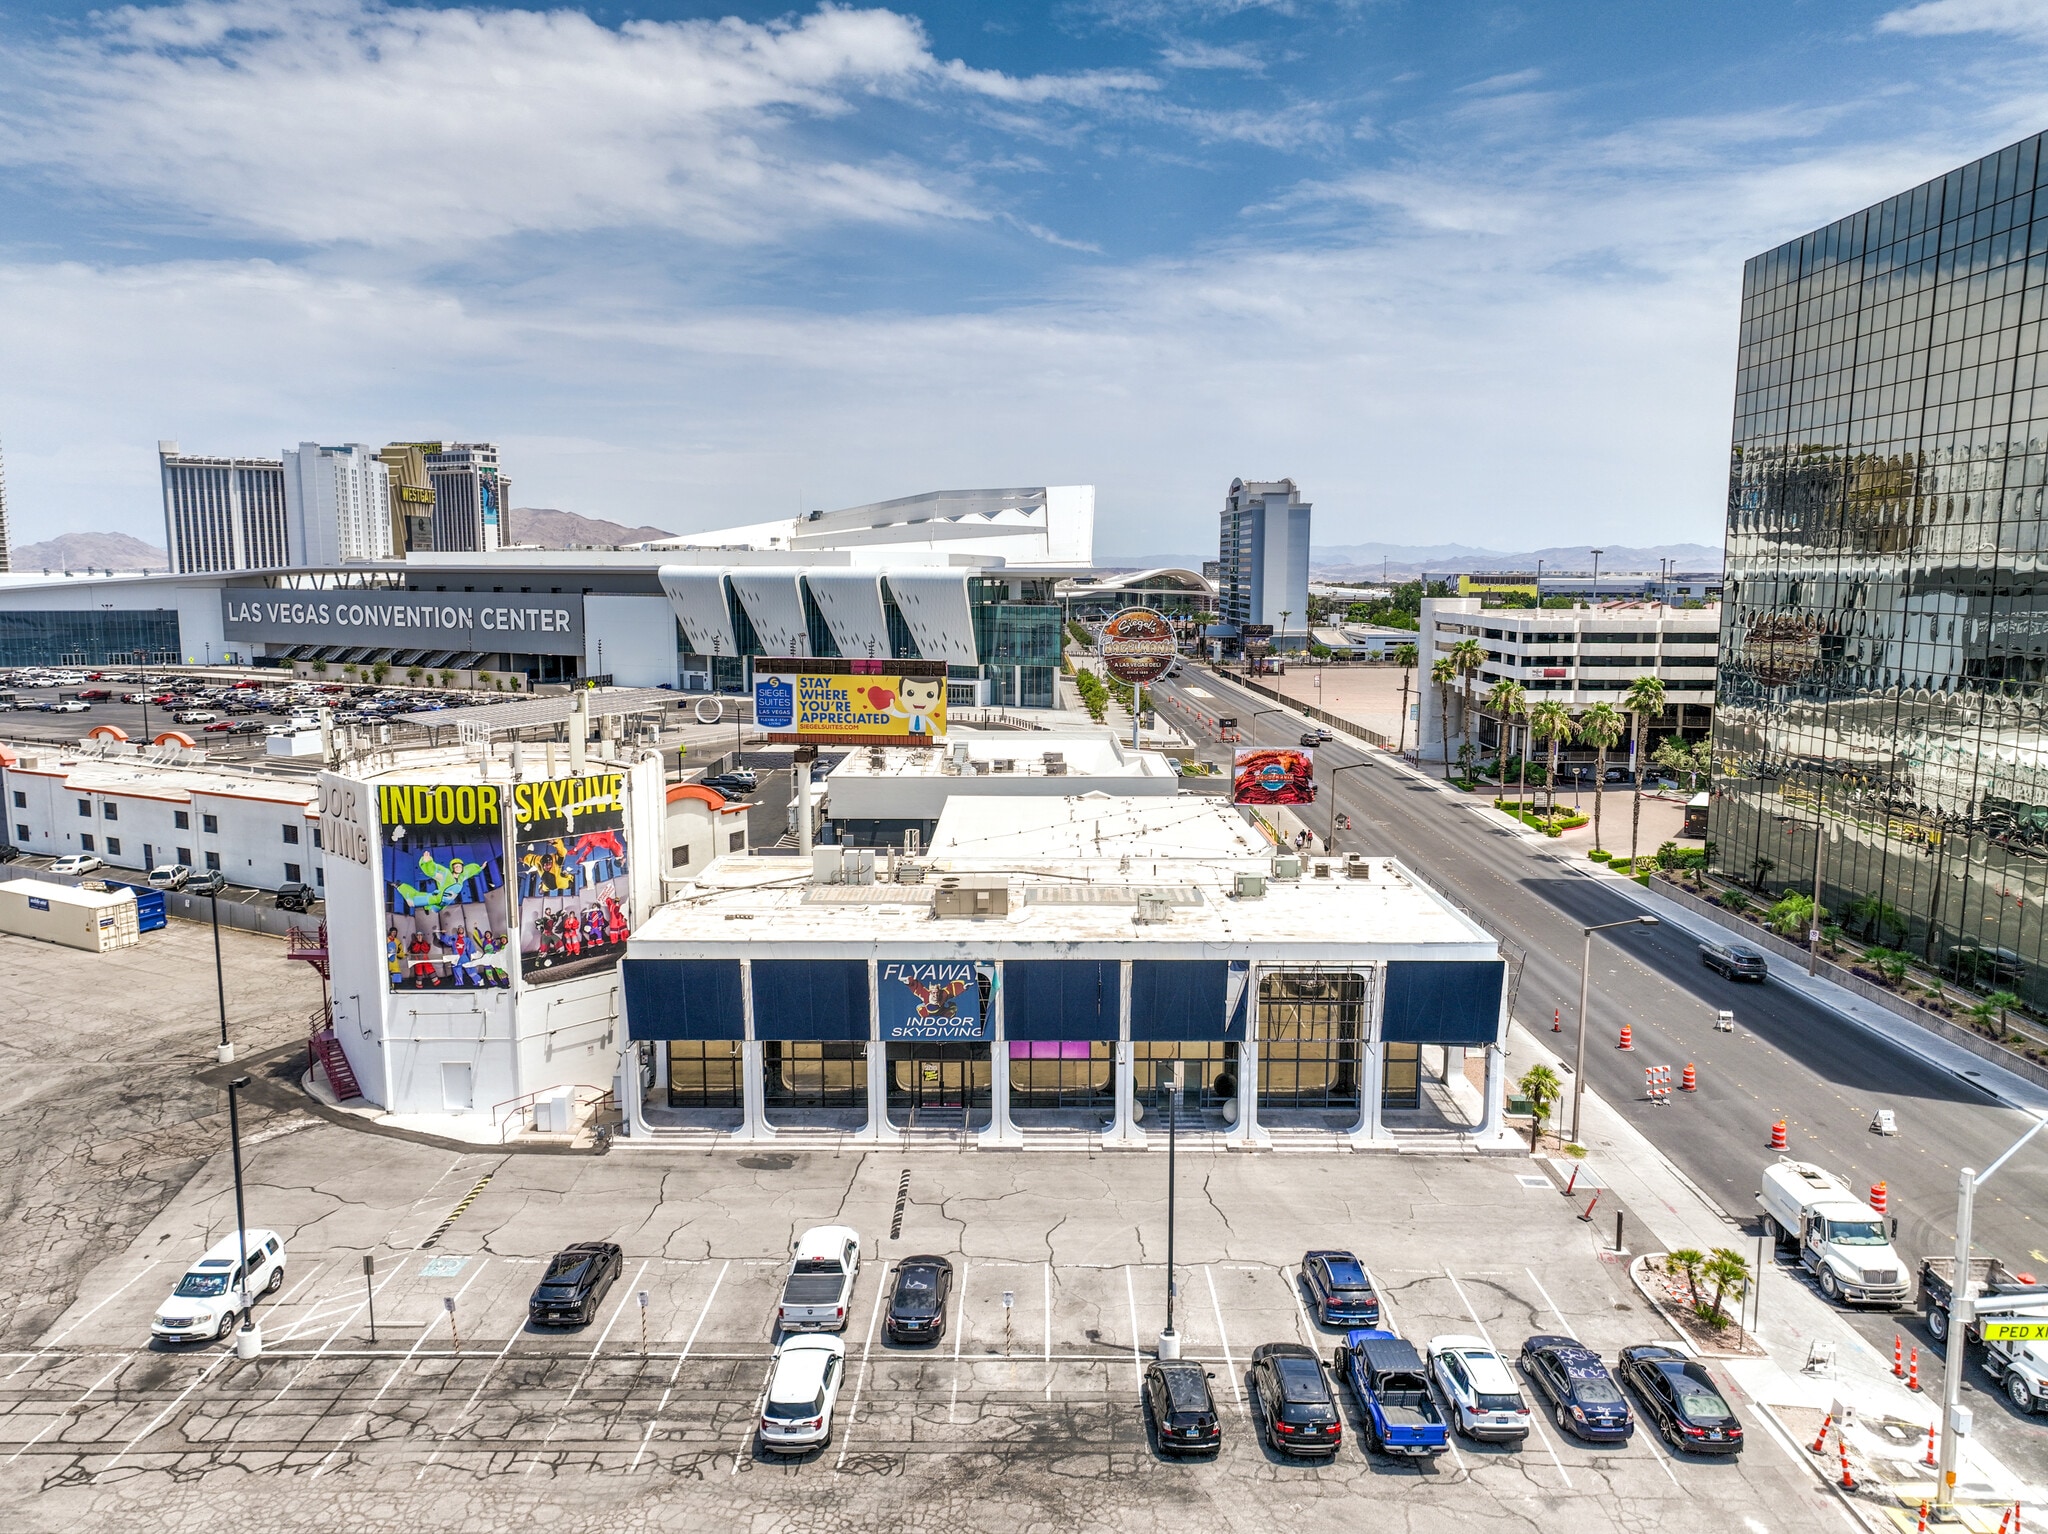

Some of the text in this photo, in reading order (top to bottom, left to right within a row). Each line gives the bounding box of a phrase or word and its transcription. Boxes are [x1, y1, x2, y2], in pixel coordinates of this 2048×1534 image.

[402, 486, 435, 504] WESTGATE
[228, 602, 571, 632] LAS VEGAS CONVENTION CENTER
[1118, 619, 1157, 634] Siegel's
[800, 677, 832, 688] STAY
[758, 689, 790, 698] SIEGEL
[799, 689, 848, 700] WHERE
[758, 699, 791, 707] SUITES
[799, 700, 851, 712] YOU'RE
[800, 713, 890, 724] APPRECIATED
[379, 774, 624, 825] INDOOR SKYDIVE
[906, 1017, 975, 1026] INDOOR
[891, 1027, 982, 1037] SKYDIVING
[1999, 1326, 2029, 1338] PED
